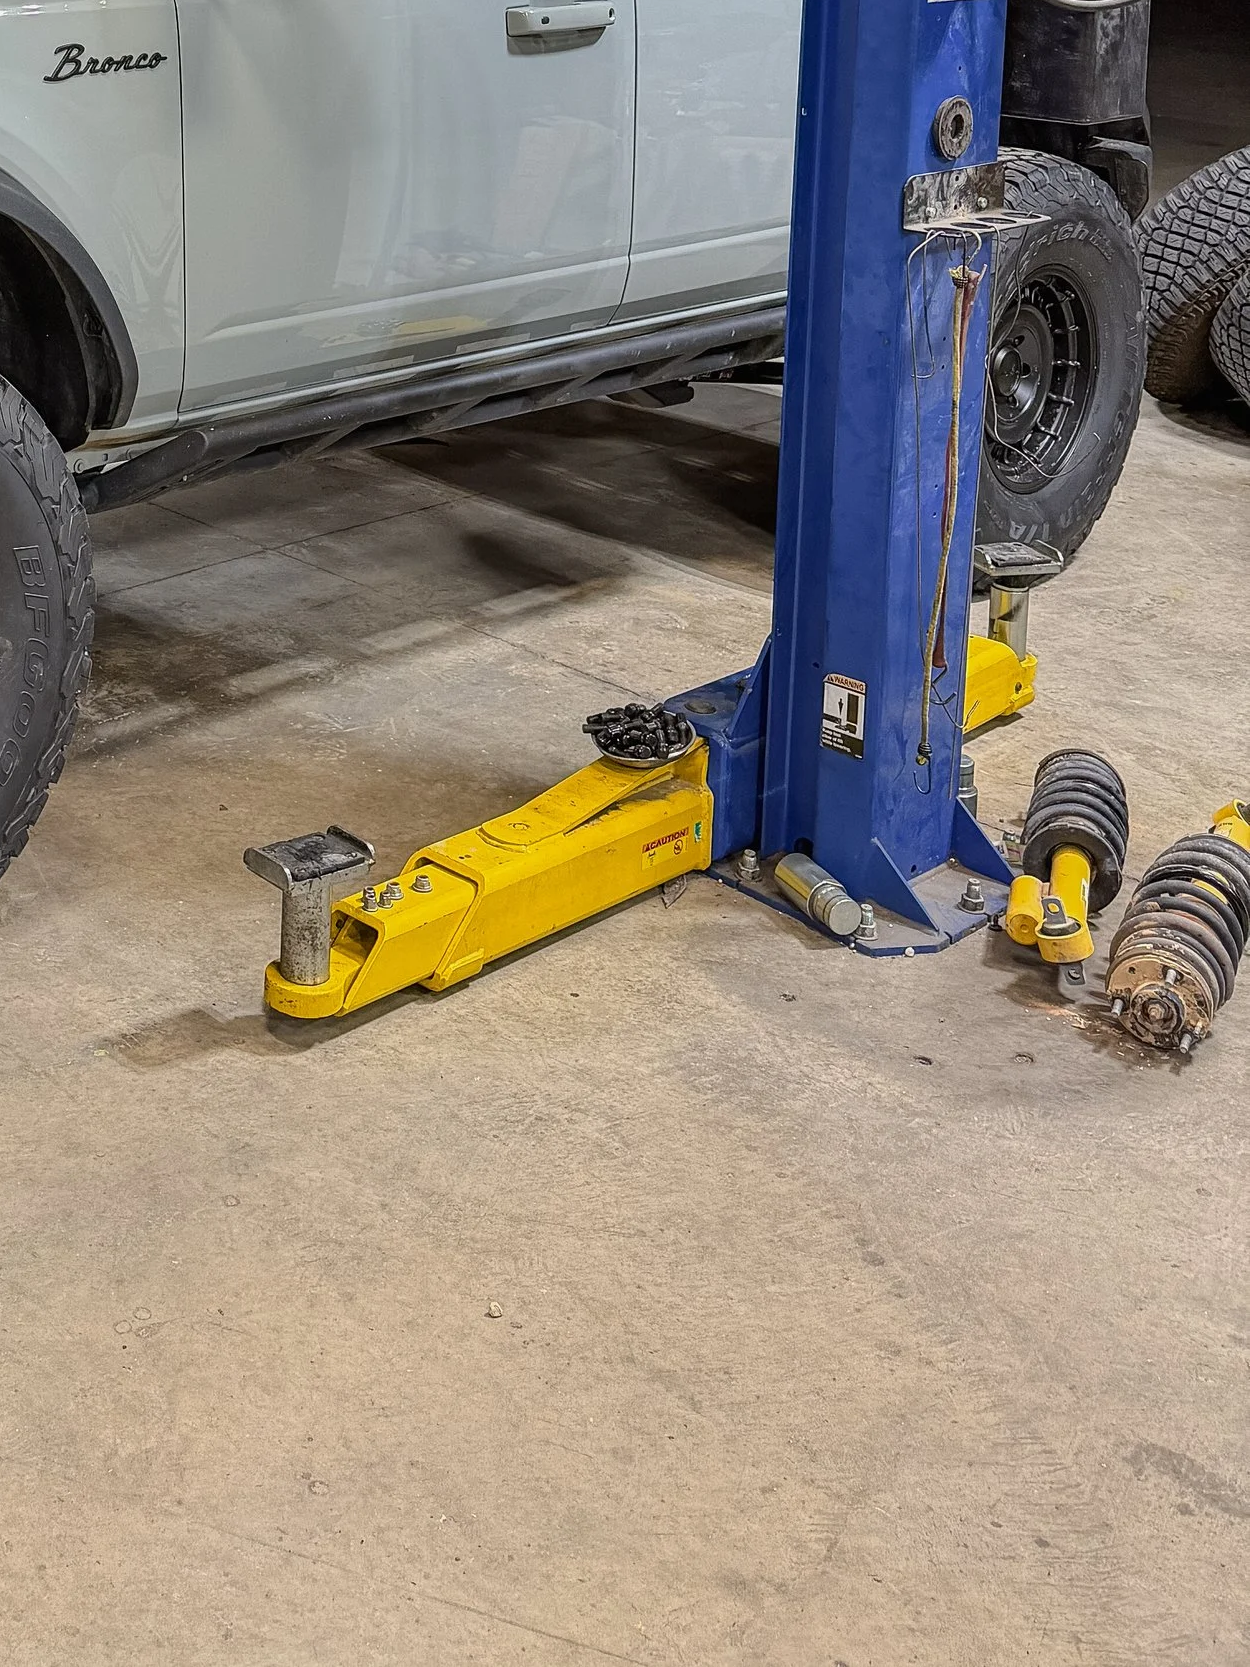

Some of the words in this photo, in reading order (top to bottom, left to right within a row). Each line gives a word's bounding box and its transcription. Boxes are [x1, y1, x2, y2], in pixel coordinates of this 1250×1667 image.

[43, 43, 168, 83] Bronco
[834, 676, 864, 692] WARNING
[650, 827, 688, 850] CAUTION
